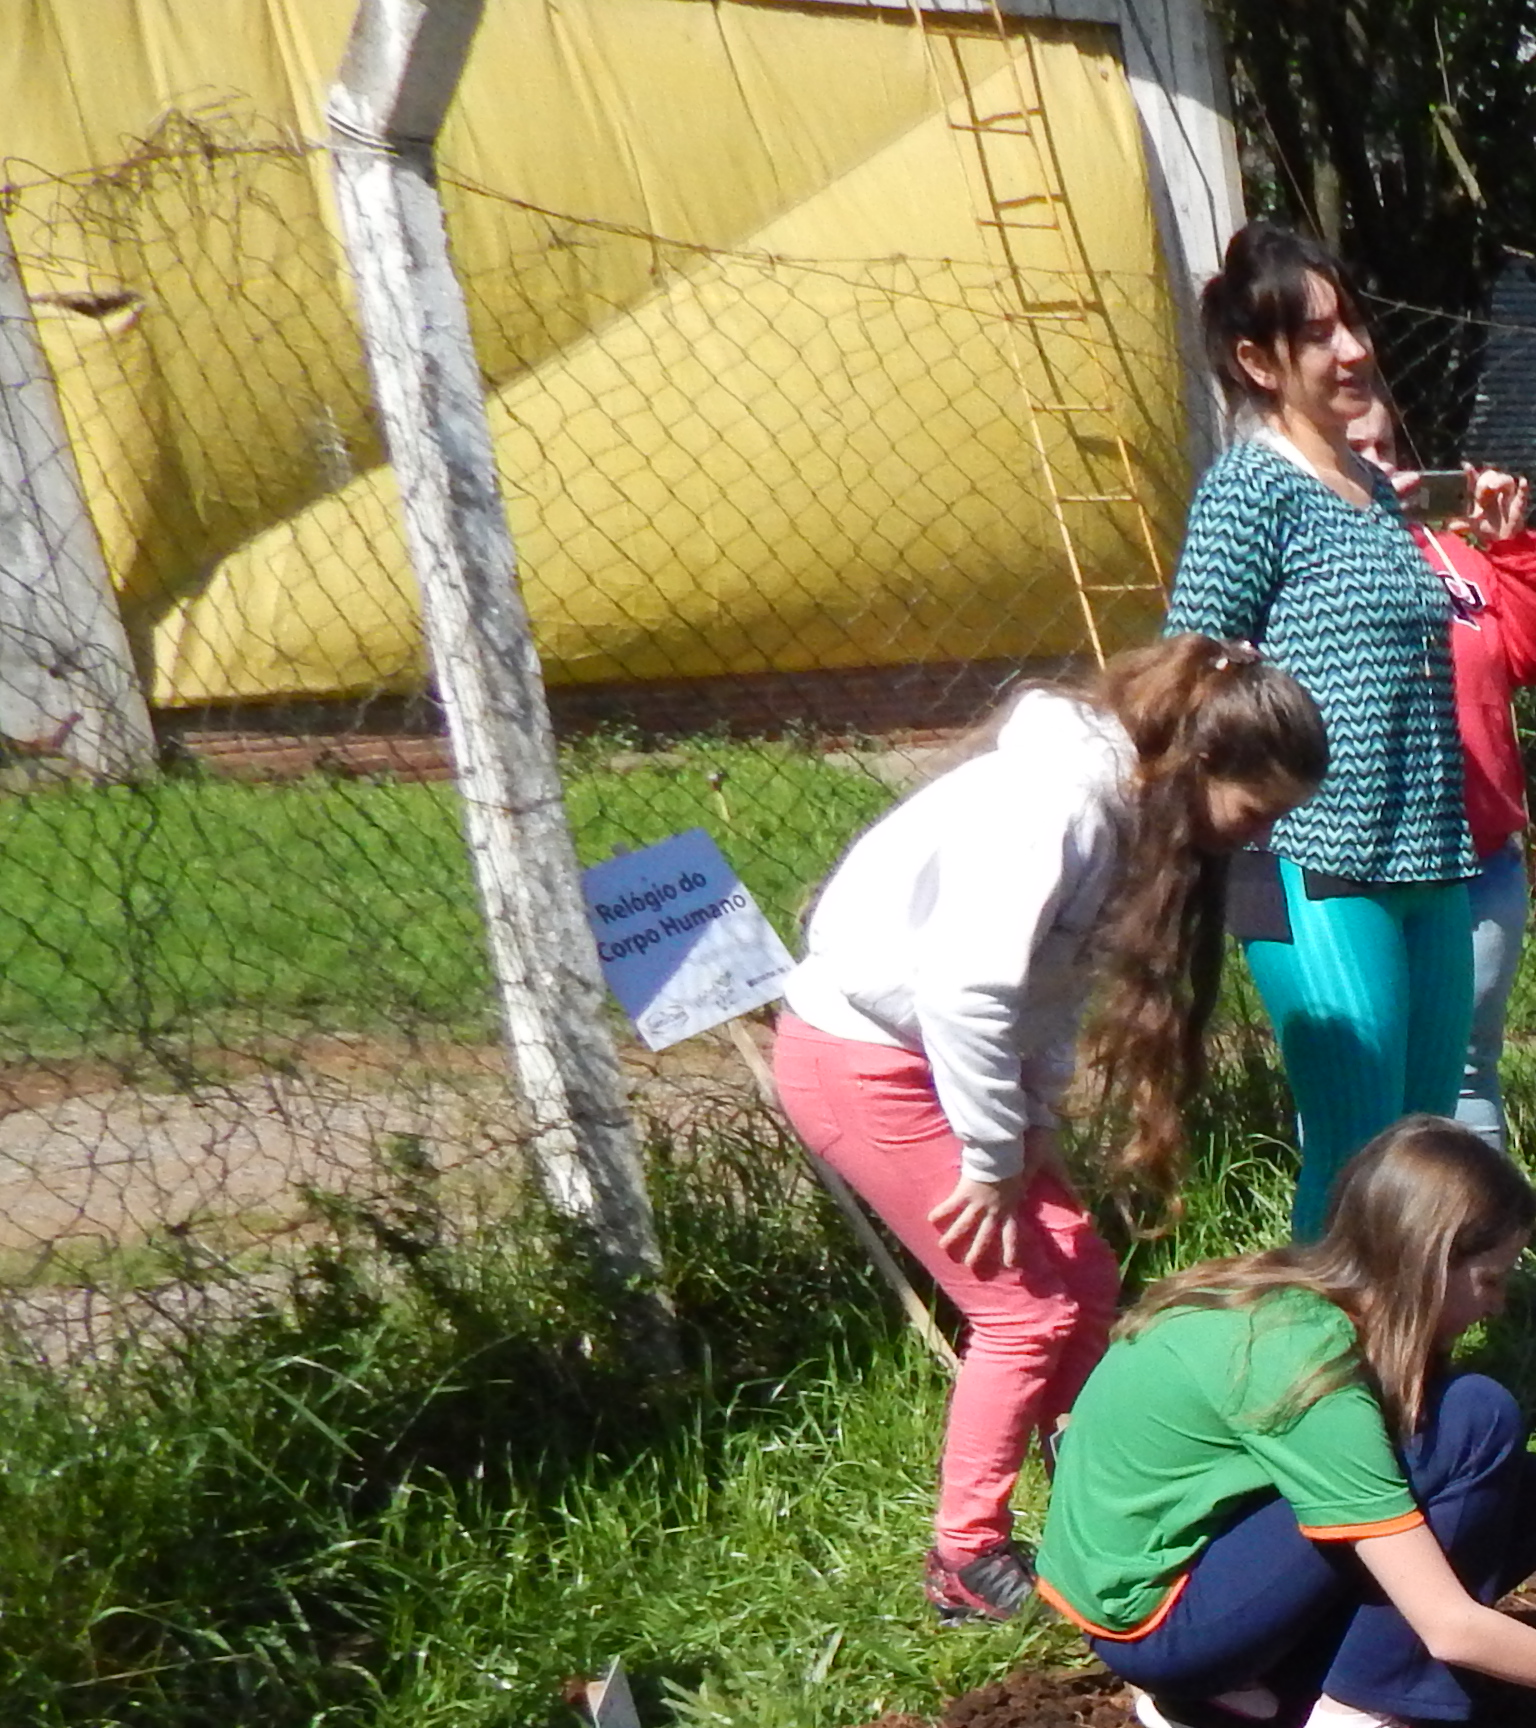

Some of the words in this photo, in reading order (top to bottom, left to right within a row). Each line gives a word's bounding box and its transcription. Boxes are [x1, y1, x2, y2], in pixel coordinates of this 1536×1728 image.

[595, 884, 677, 924] Relógio
[678, 871, 707, 893] do
[597, 927, 661, 962] Corpo
[659, 894, 746, 937] Humano
